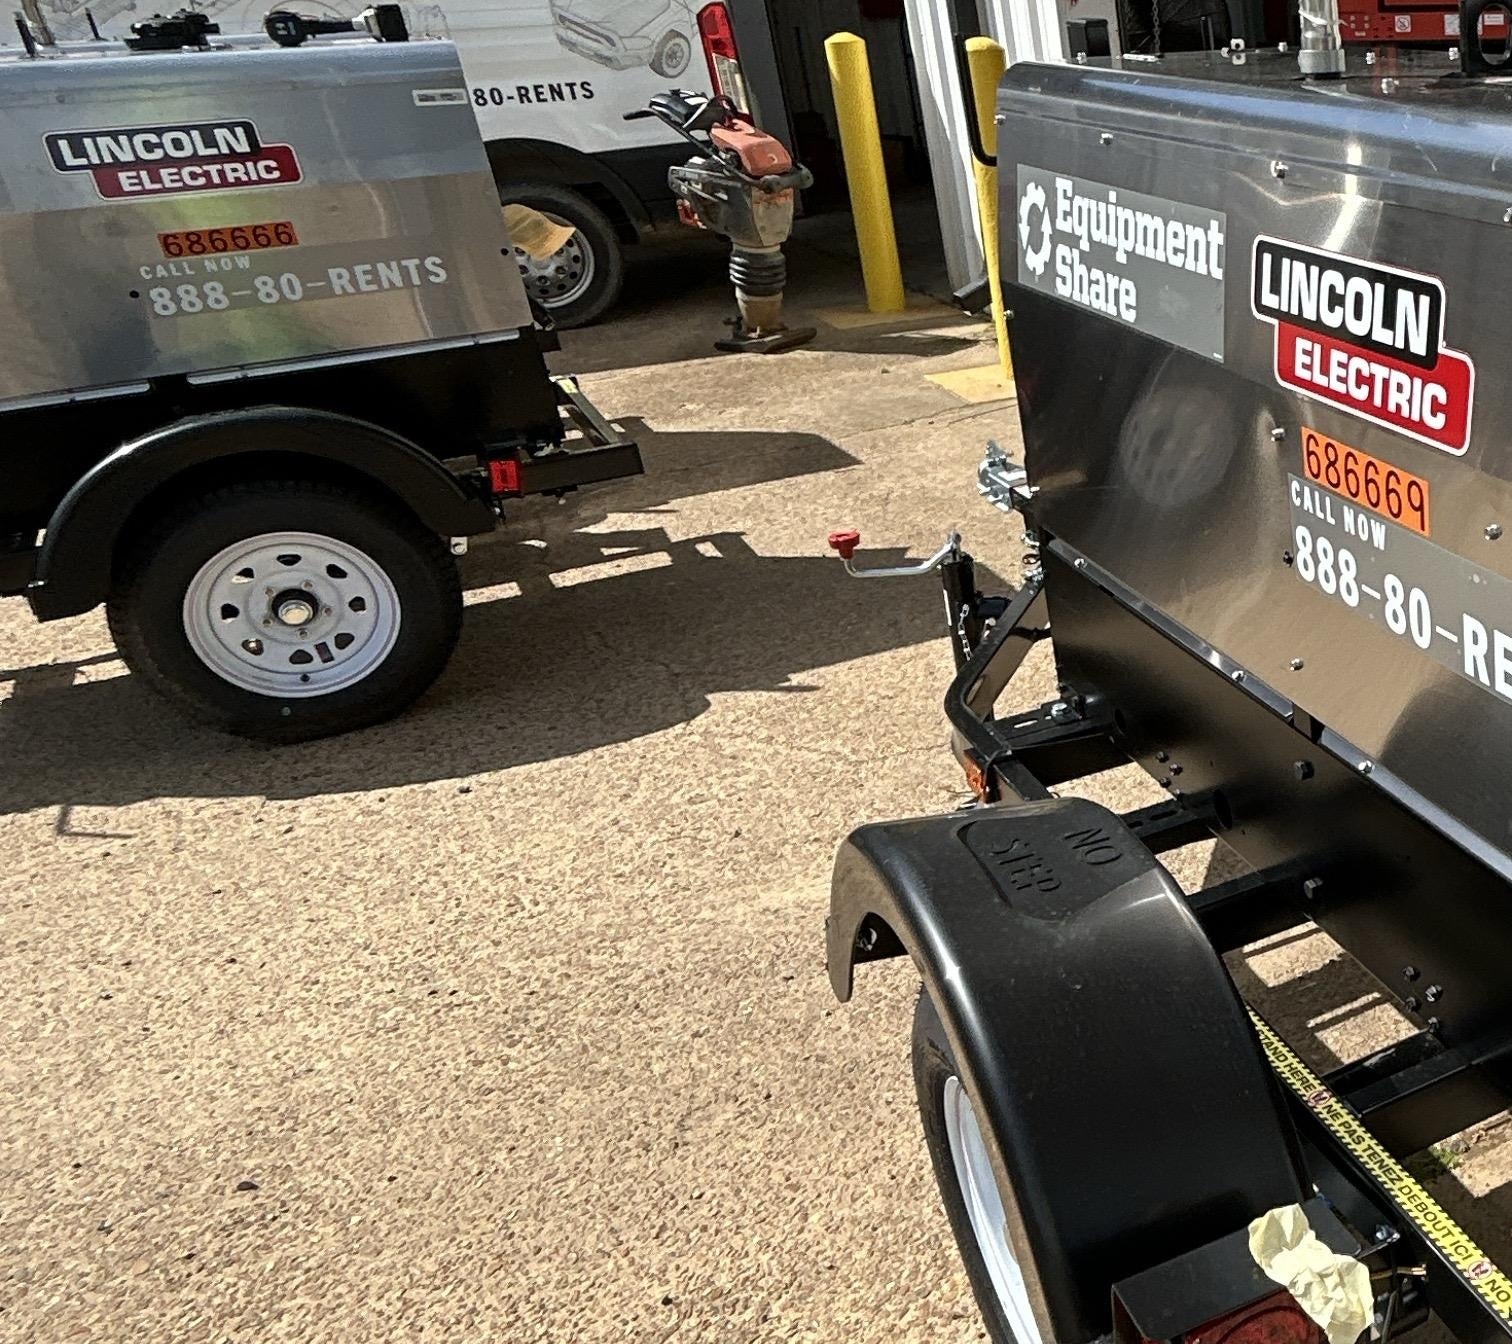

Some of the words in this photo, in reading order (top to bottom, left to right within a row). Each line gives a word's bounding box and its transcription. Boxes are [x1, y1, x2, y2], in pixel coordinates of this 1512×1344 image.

[58, 125, 252, 167] LINCOLN
[118, 159, 281, 193] ELECTRIC
[163, 223, 293, 256] 686666
[1055, 177, 1225, 280] Equipment
[139, 260, 195, 280] CALL
[203, 255, 251, 273] NOW
[149, 256, 449, 317] 888-80-RENTS
[1055, 244, 1137, 323] Share
[1261, 252, 1431, 356] LINCOLN
[1294, 336, 1448, 431] ELECTRIC
[1291, 480, 1336, 526] CALL
[1343, 505, 1387, 551] NOW
[1305, 433, 1426, 532] 686669
[1064, 828, 1123, 865] NO
[1260, 1029, 1288, 1062] TAND
[1283, 1060, 1317, 1094] HERE
[1322, 1103, 1343, 1121] NE
[1339, 1120, 1366, 1145] PAS
[1361, 1144, 1406, 1186] TENEZ
[1398, 1184, 1458, 1246] DEBOUT
[1450, 1240, 1474, 1262] ICI
[1485, 1279, 1510, 1302] NO
